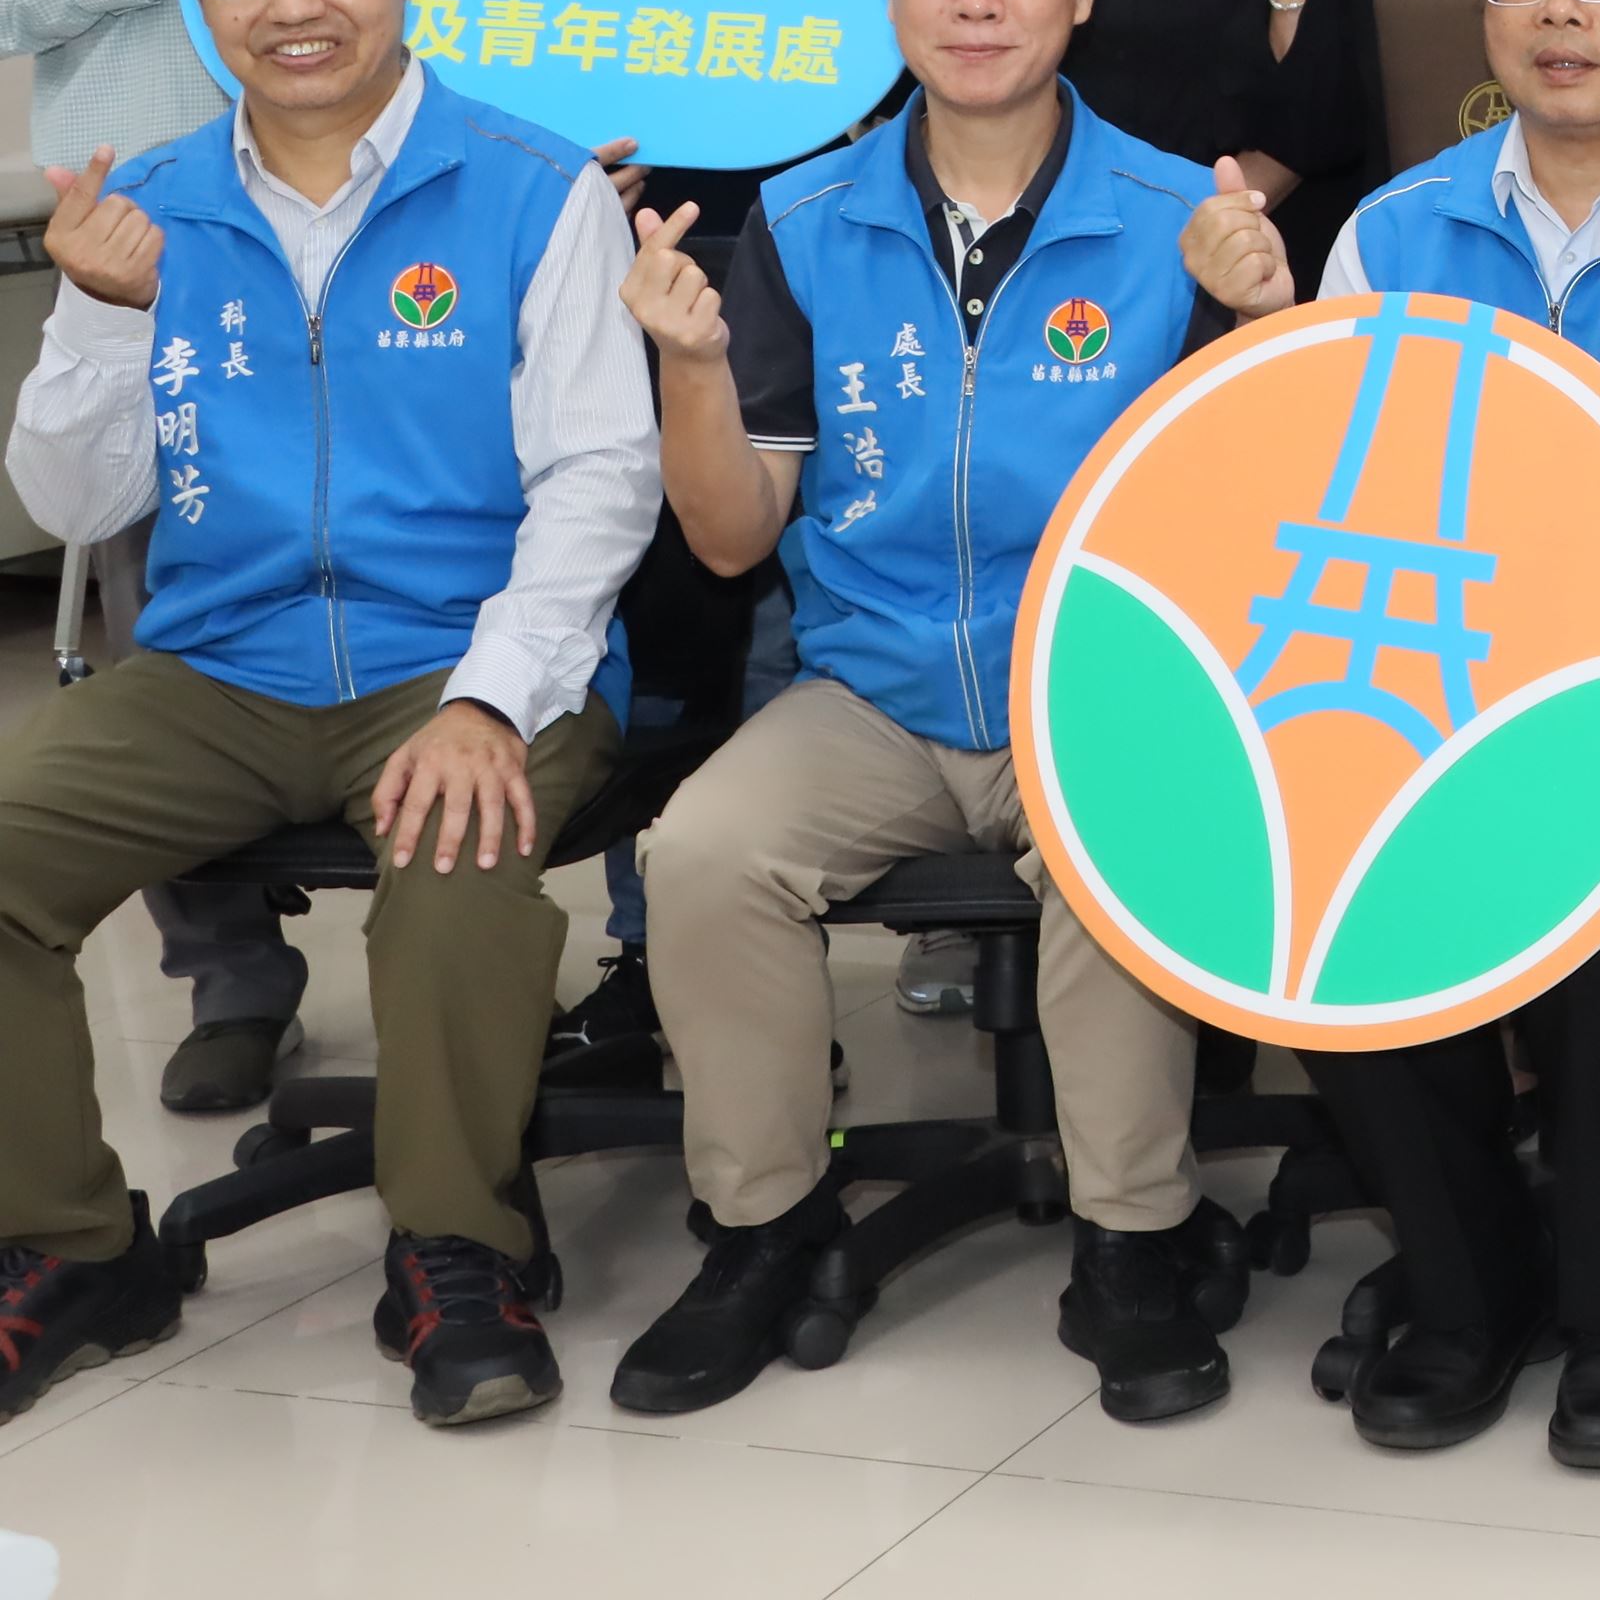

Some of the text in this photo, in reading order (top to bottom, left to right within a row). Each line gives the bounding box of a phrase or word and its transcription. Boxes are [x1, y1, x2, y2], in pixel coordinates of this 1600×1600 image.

[219, 298, 255, 380] 科長
[377, 328, 466, 349] 苗栗縣政府
[890, 322, 927, 400] 處長
[1031, 361, 1117, 384] 苗栗縣政府
[153, 336, 211, 526] 李明芳
